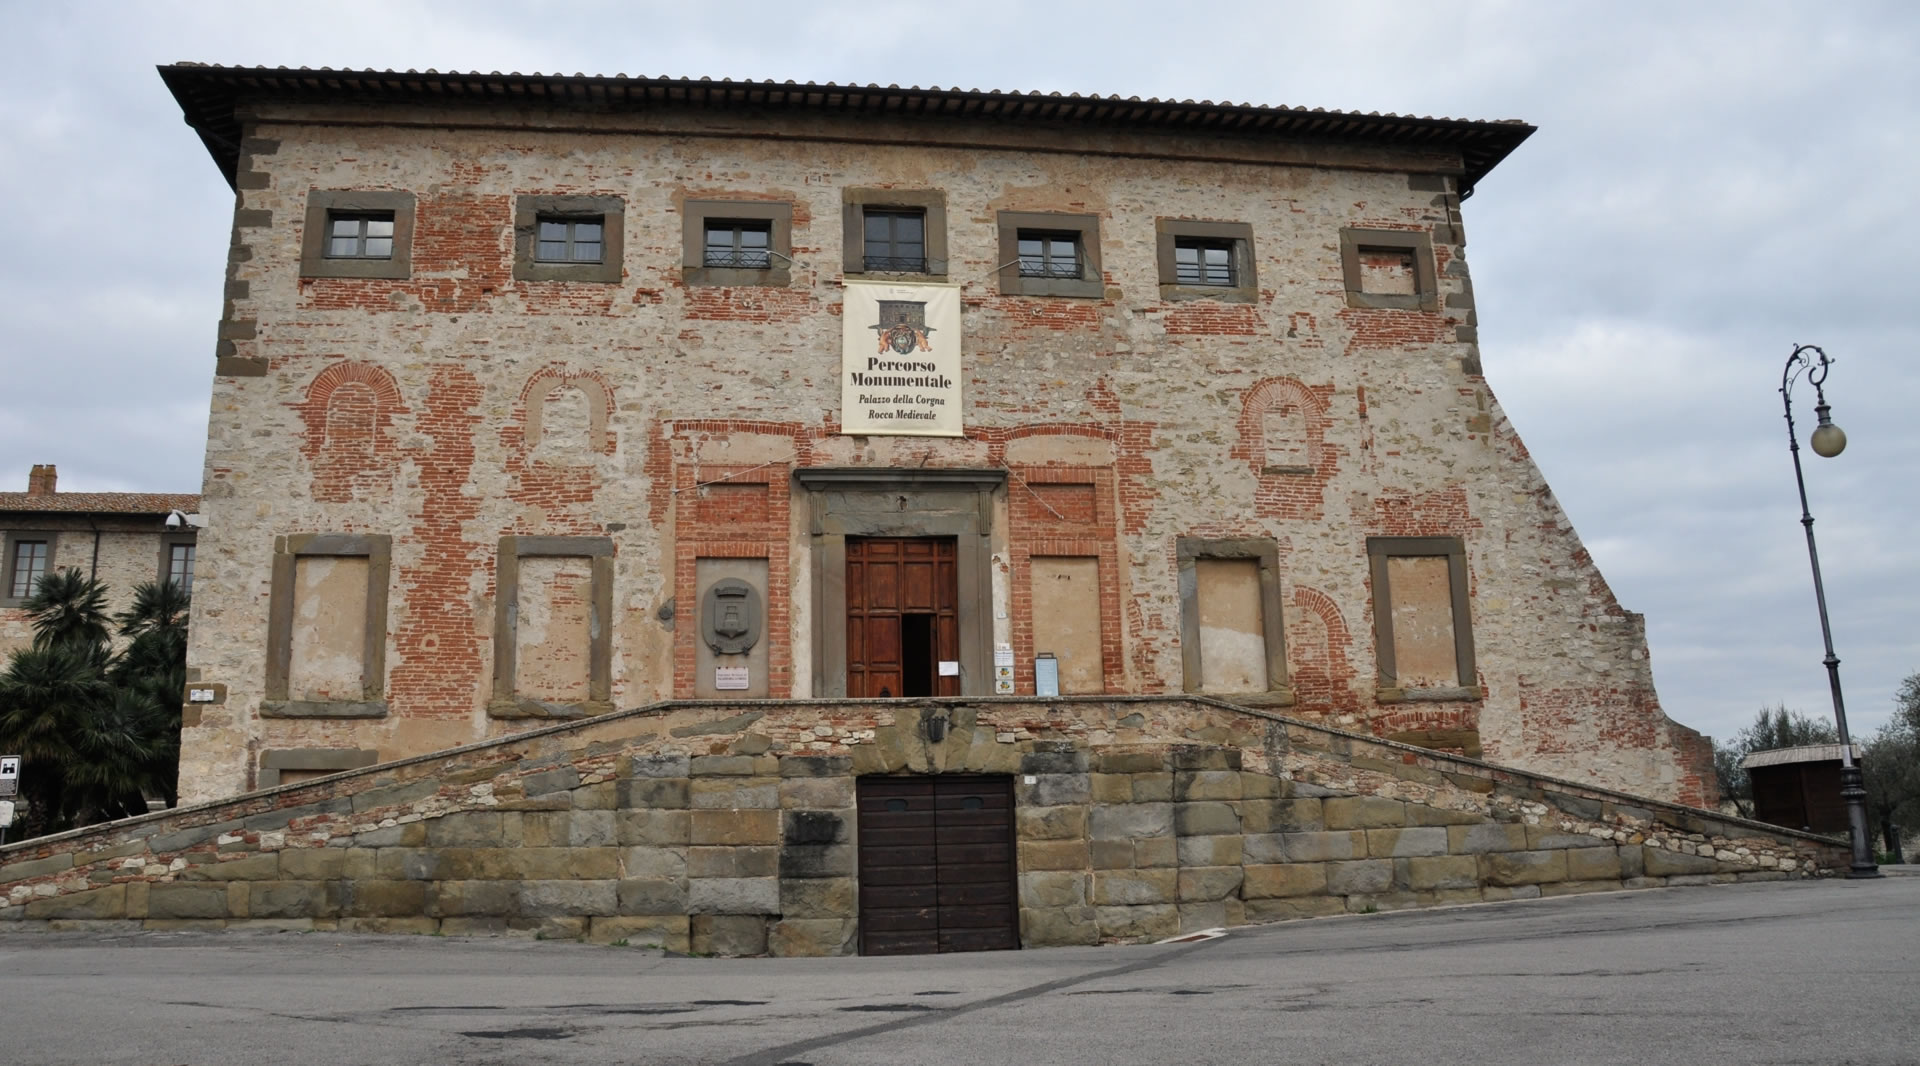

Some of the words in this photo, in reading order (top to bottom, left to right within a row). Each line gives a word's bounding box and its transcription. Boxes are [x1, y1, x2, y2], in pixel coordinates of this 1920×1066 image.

[867, 357, 936, 372] Percorso
[850, 372, 952, 389] Monumentale
[859, 394, 891, 404] Palazzo
[893, 394, 914, 404] della
[915, 394, 945, 407] Corgna
[868, 409, 893, 419] Rocca
[896, 409, 936, 420] Medievale
